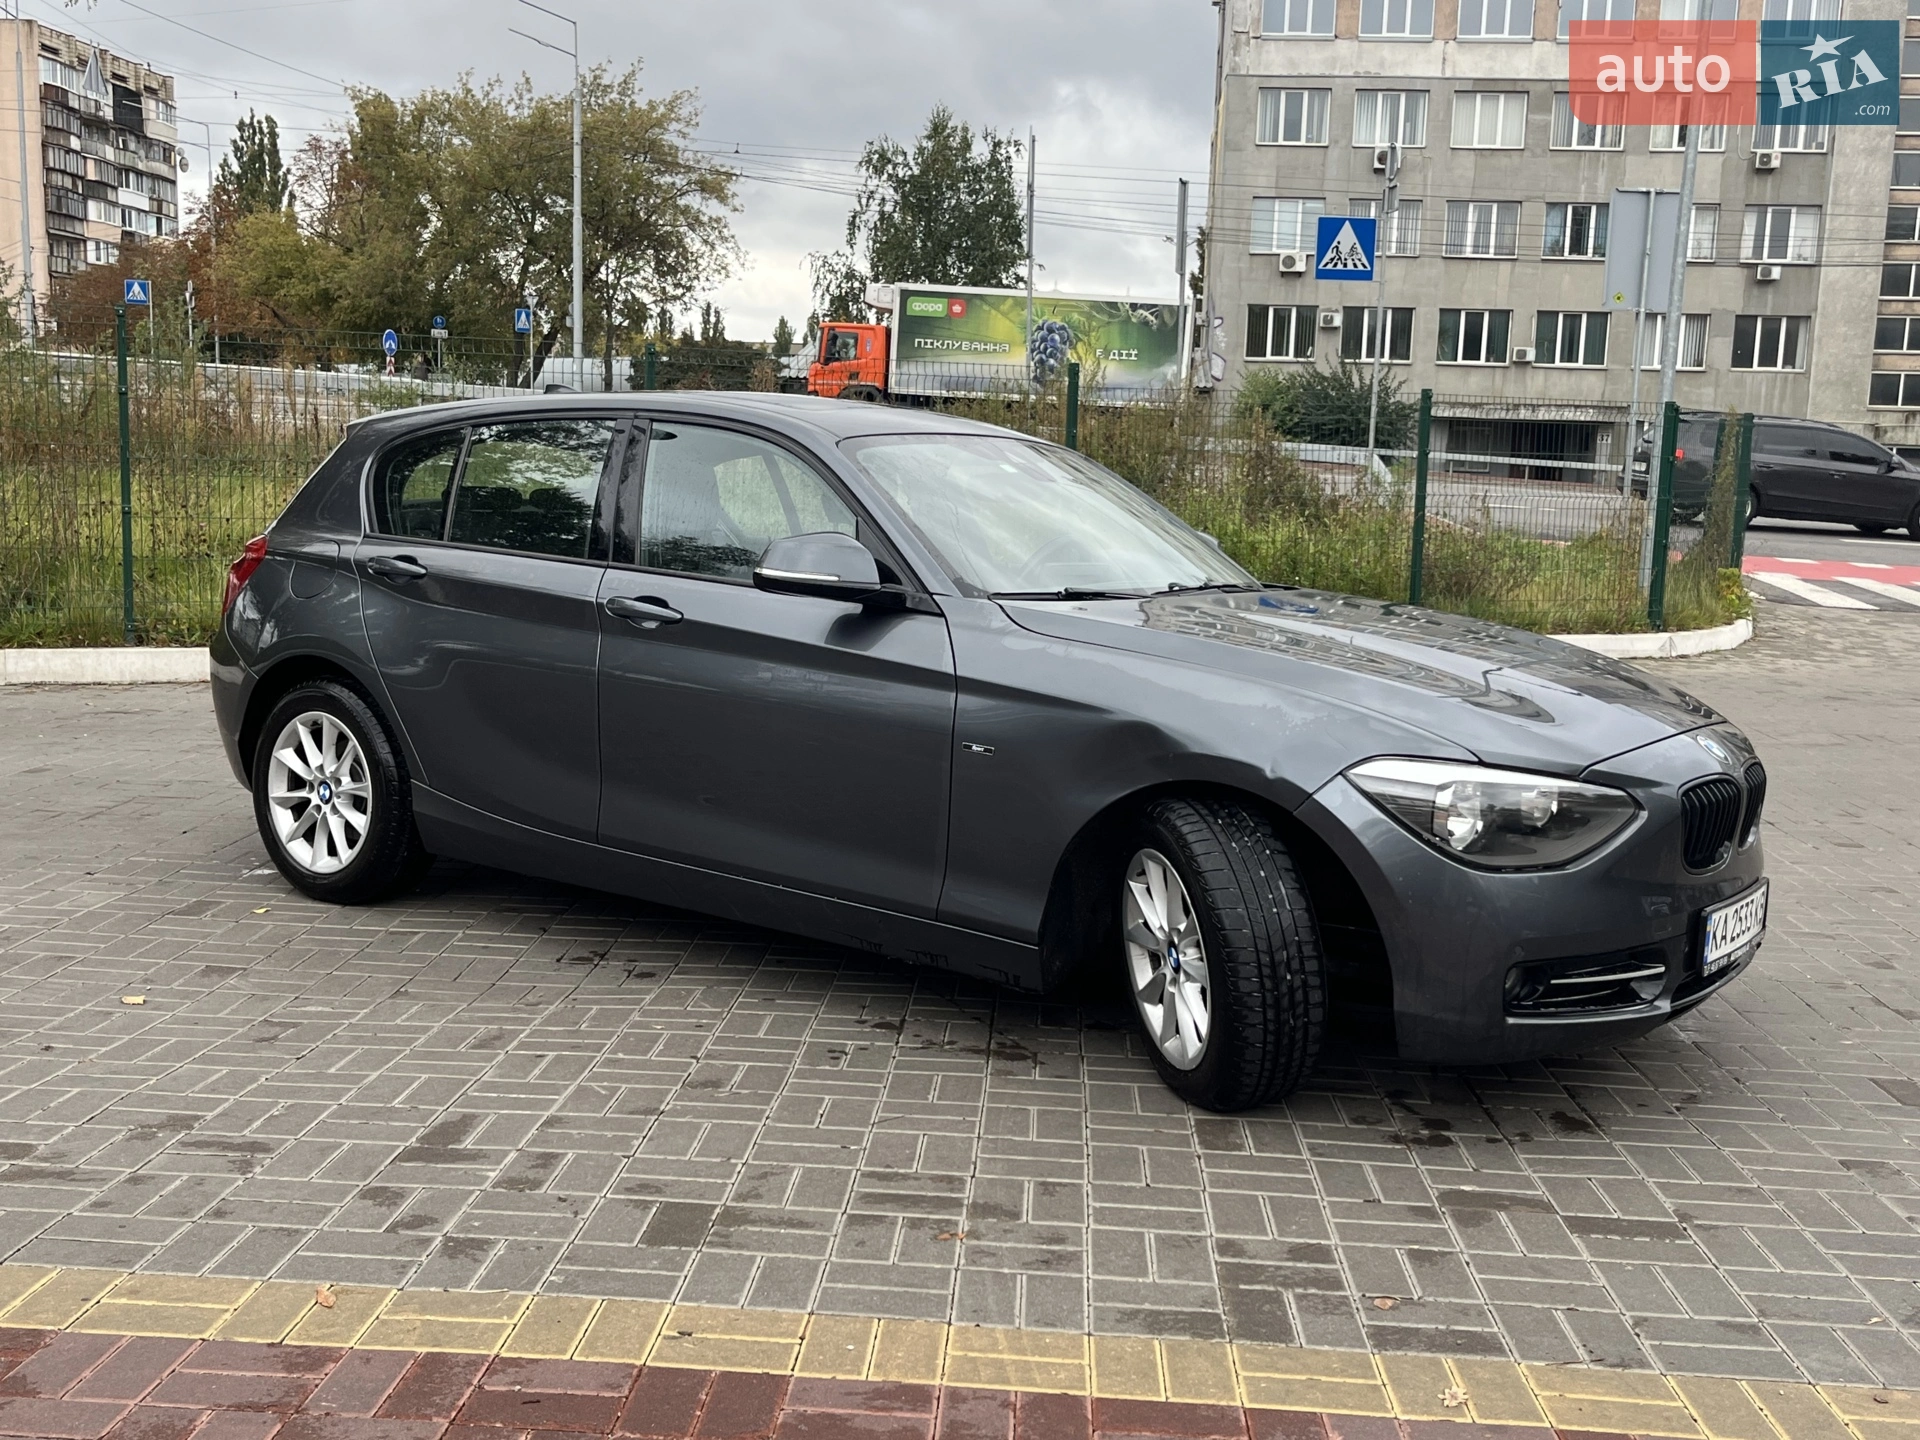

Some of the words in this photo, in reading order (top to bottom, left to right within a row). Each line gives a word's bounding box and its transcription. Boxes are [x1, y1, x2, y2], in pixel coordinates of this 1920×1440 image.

[914, 338, 1010, 353] ПІКЛУВАННЯ
[1108, 348, 1138, 361] ДІЇ
[1710, 912, 1728, 954] KA
[1729, 897, 1755, 943] 2533
